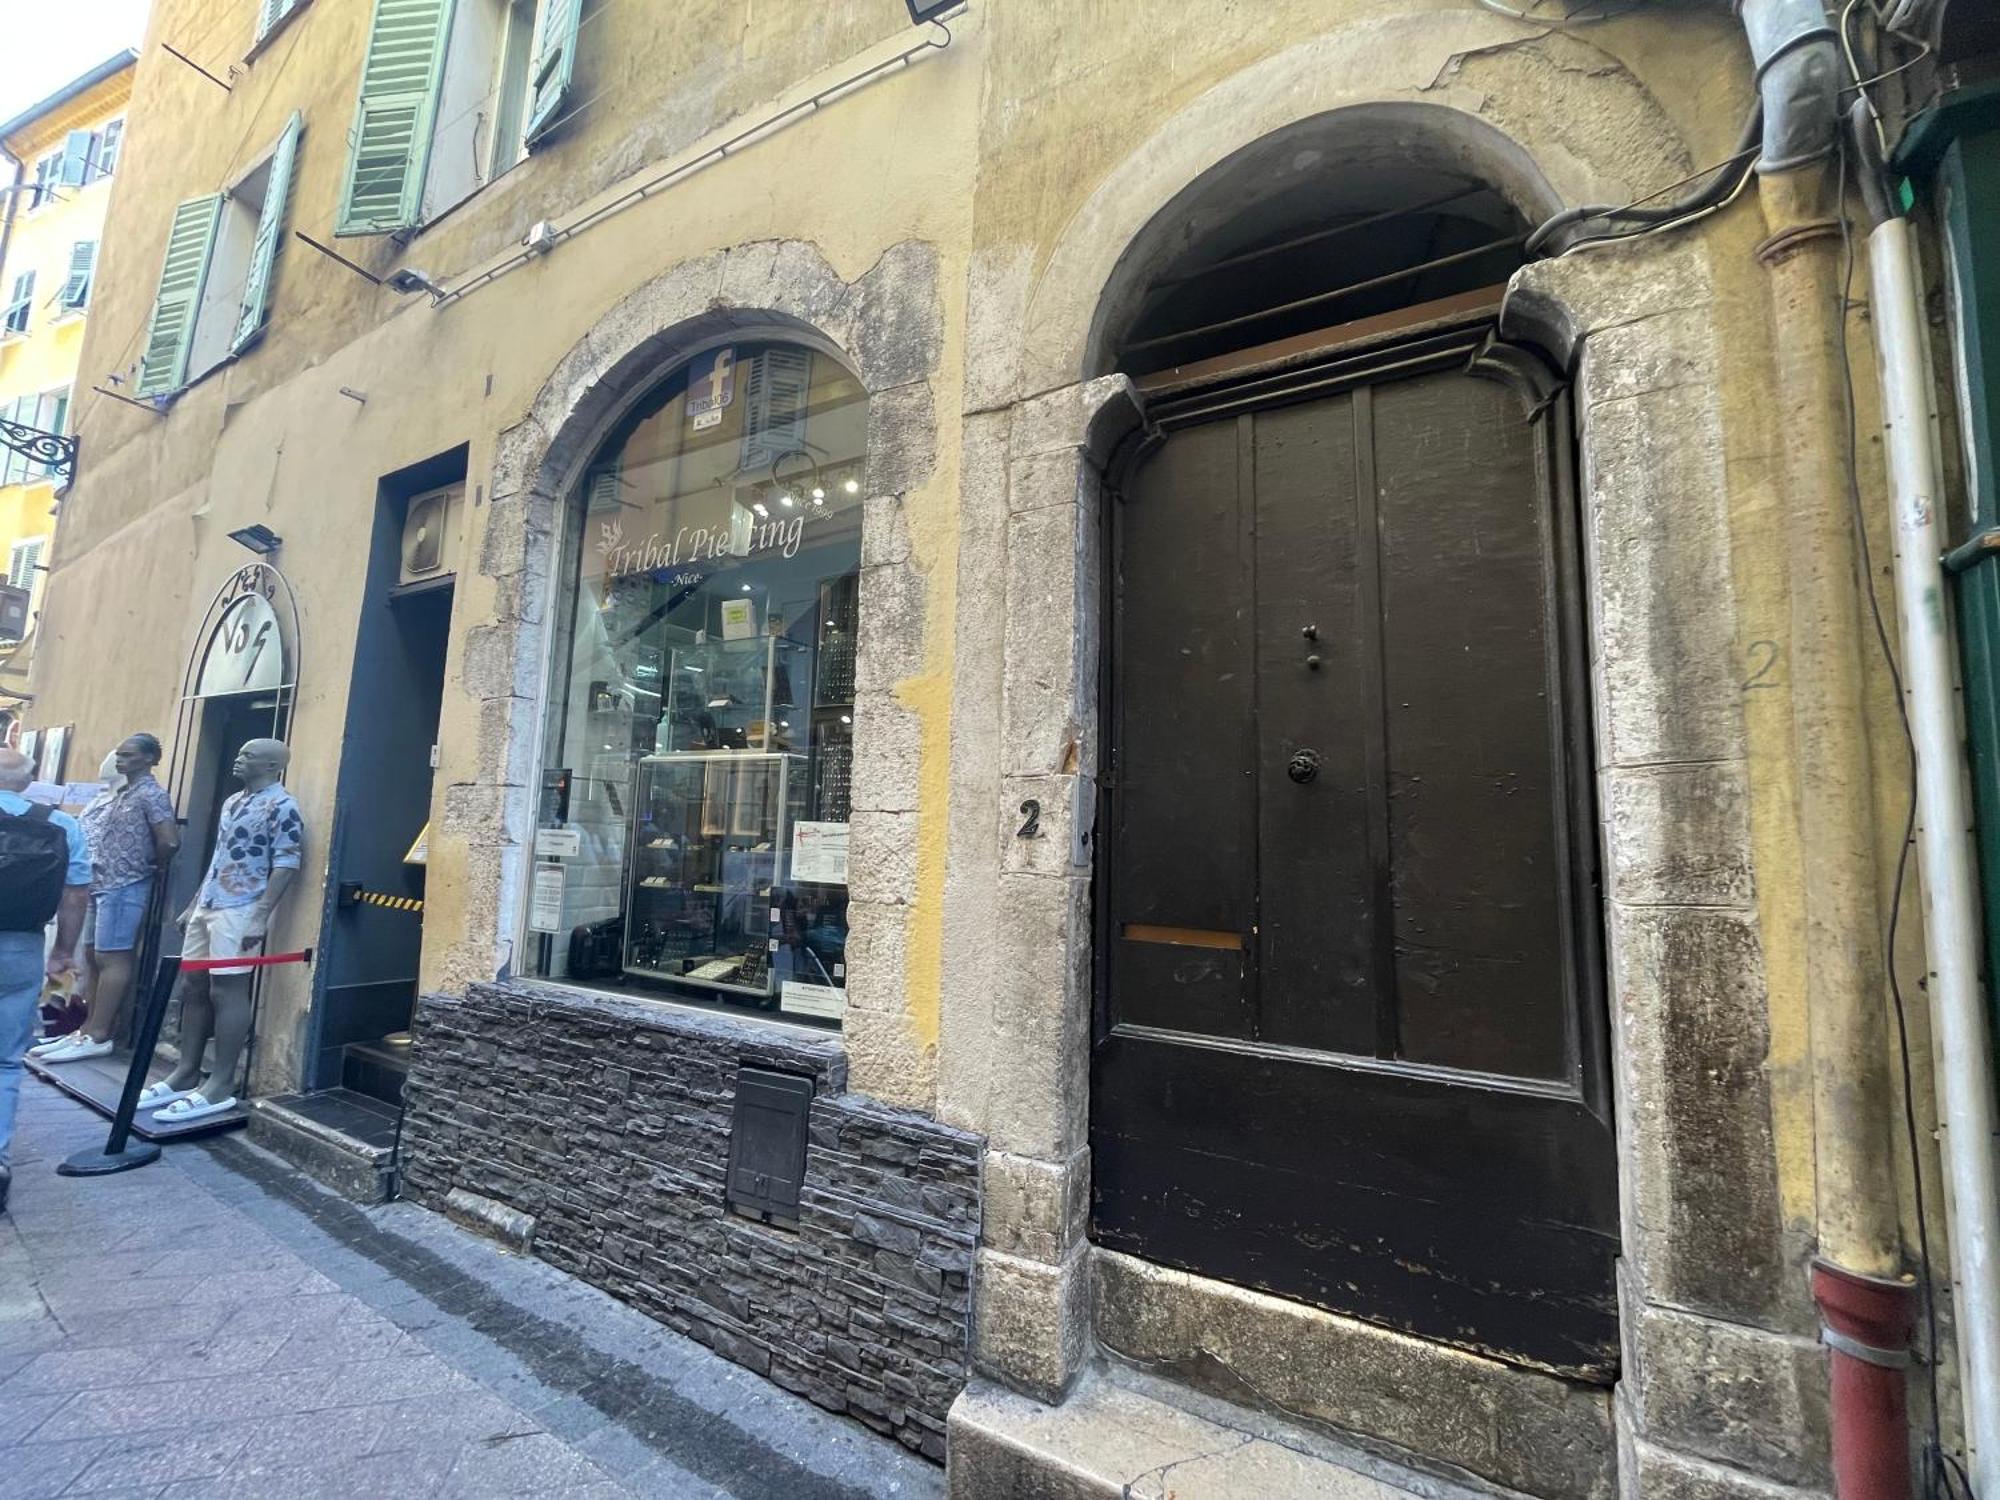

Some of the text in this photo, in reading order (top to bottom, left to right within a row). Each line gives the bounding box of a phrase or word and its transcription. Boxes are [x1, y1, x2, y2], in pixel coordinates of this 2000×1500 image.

[609, 515, 805, 577] Tribal Piecing
[1741, 639, 1780, 692] 2
[1016, 799, 1040, 838] 2
